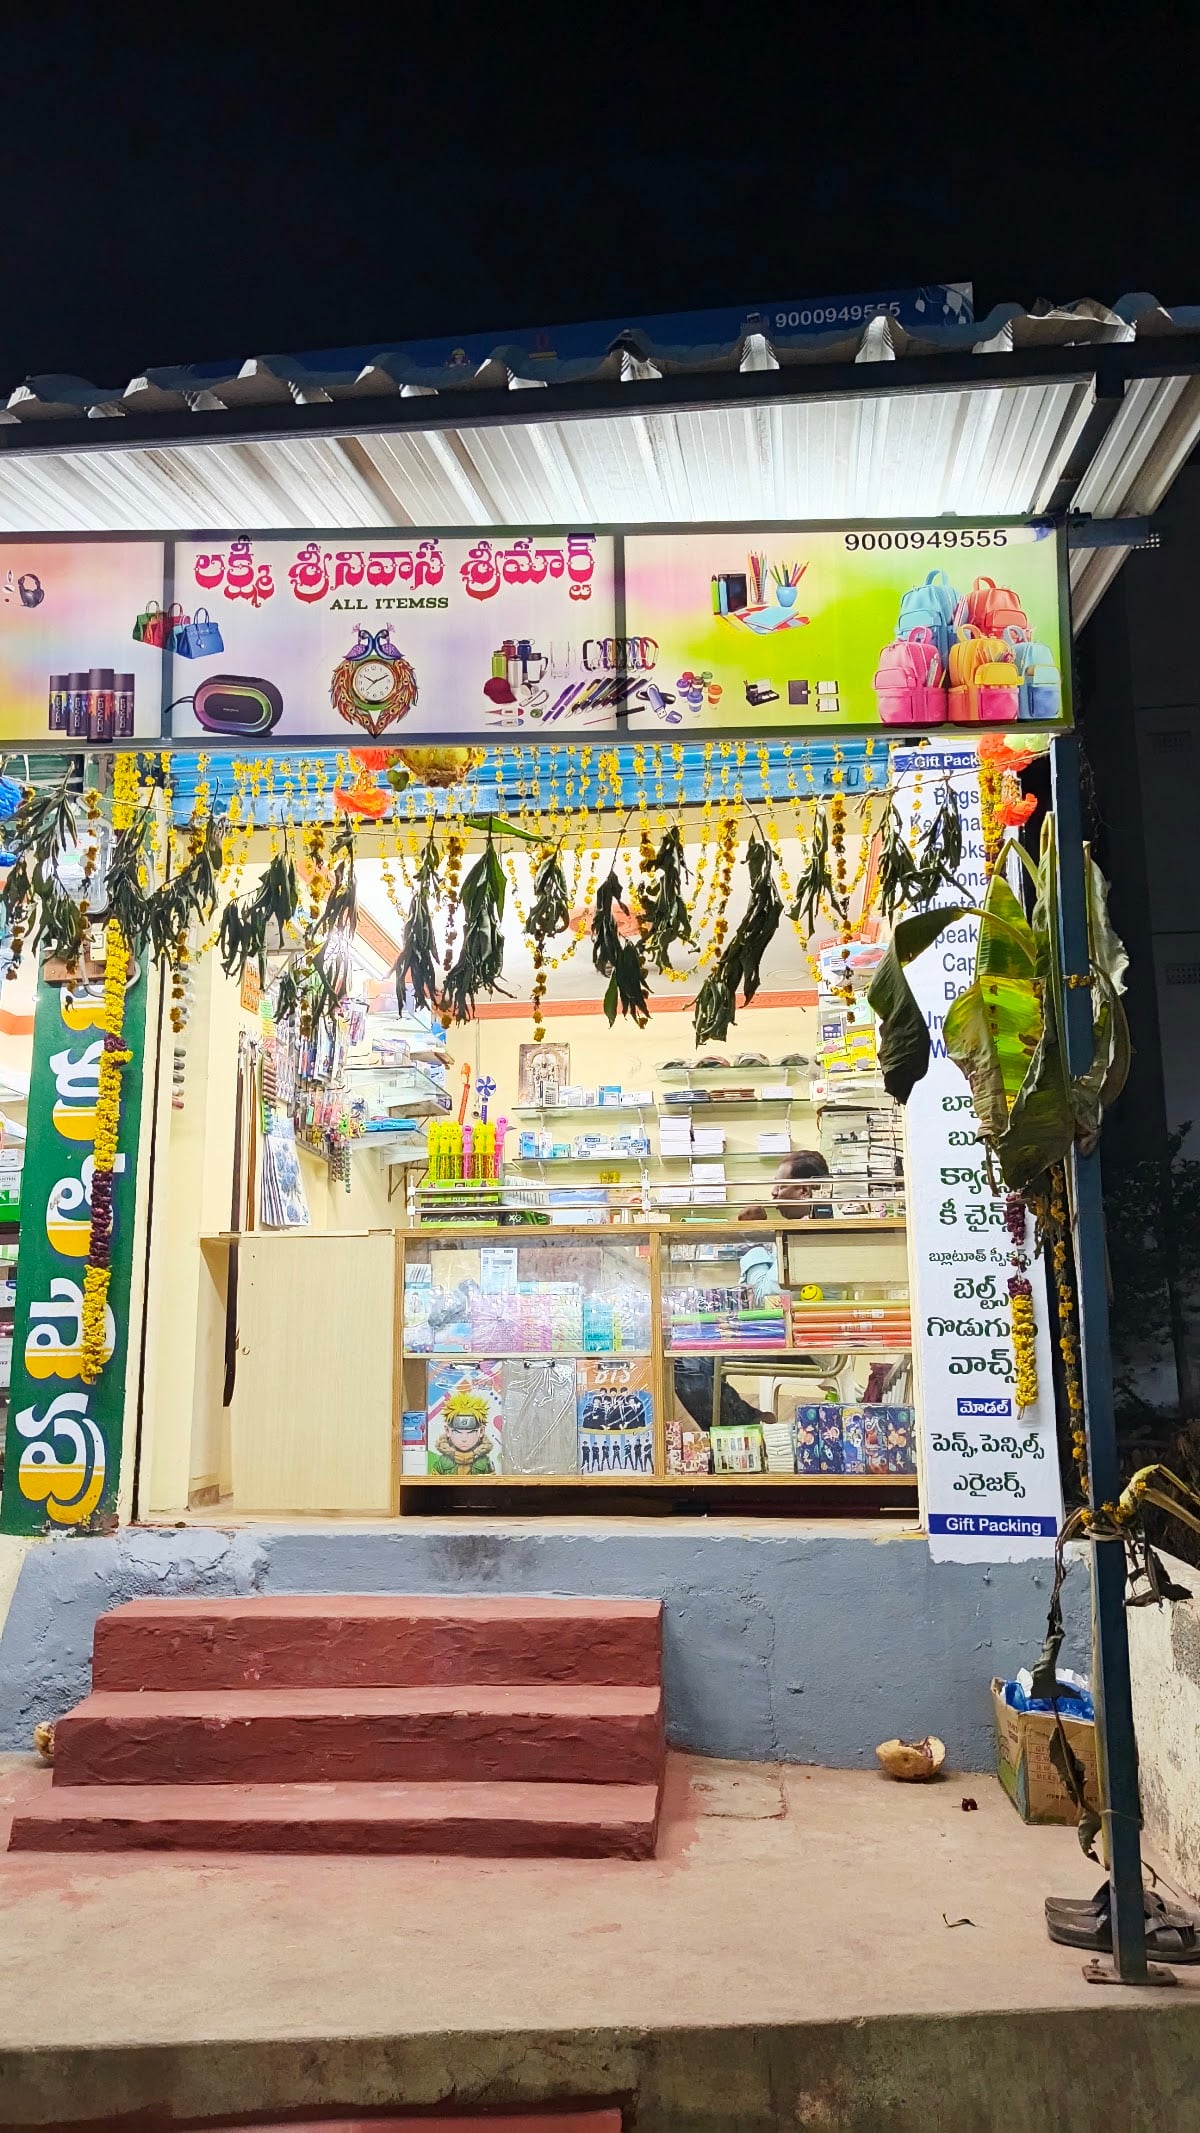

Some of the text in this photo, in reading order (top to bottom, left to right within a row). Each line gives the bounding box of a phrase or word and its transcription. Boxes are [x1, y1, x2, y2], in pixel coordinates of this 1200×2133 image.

[775, 301, 901, 328] 900094955
[844, 529, 1008, 551] 9000949555
[330, 597, 449, 610] ALL ITEMSS
[914, 753, 979, 768] Gift Pack
[934, 788, 979, 809] Bgs
[939, 1198, 958, 1226] కీ
[959, 1399, 1009, 1415] మోడల్
[979, 1432, 1045, 1460] పెన్సిల్స్
[952, 1471, 1026, 1499] ఎరైజర్స్
[946, 1517, 1042, 1536] Gift Packing
